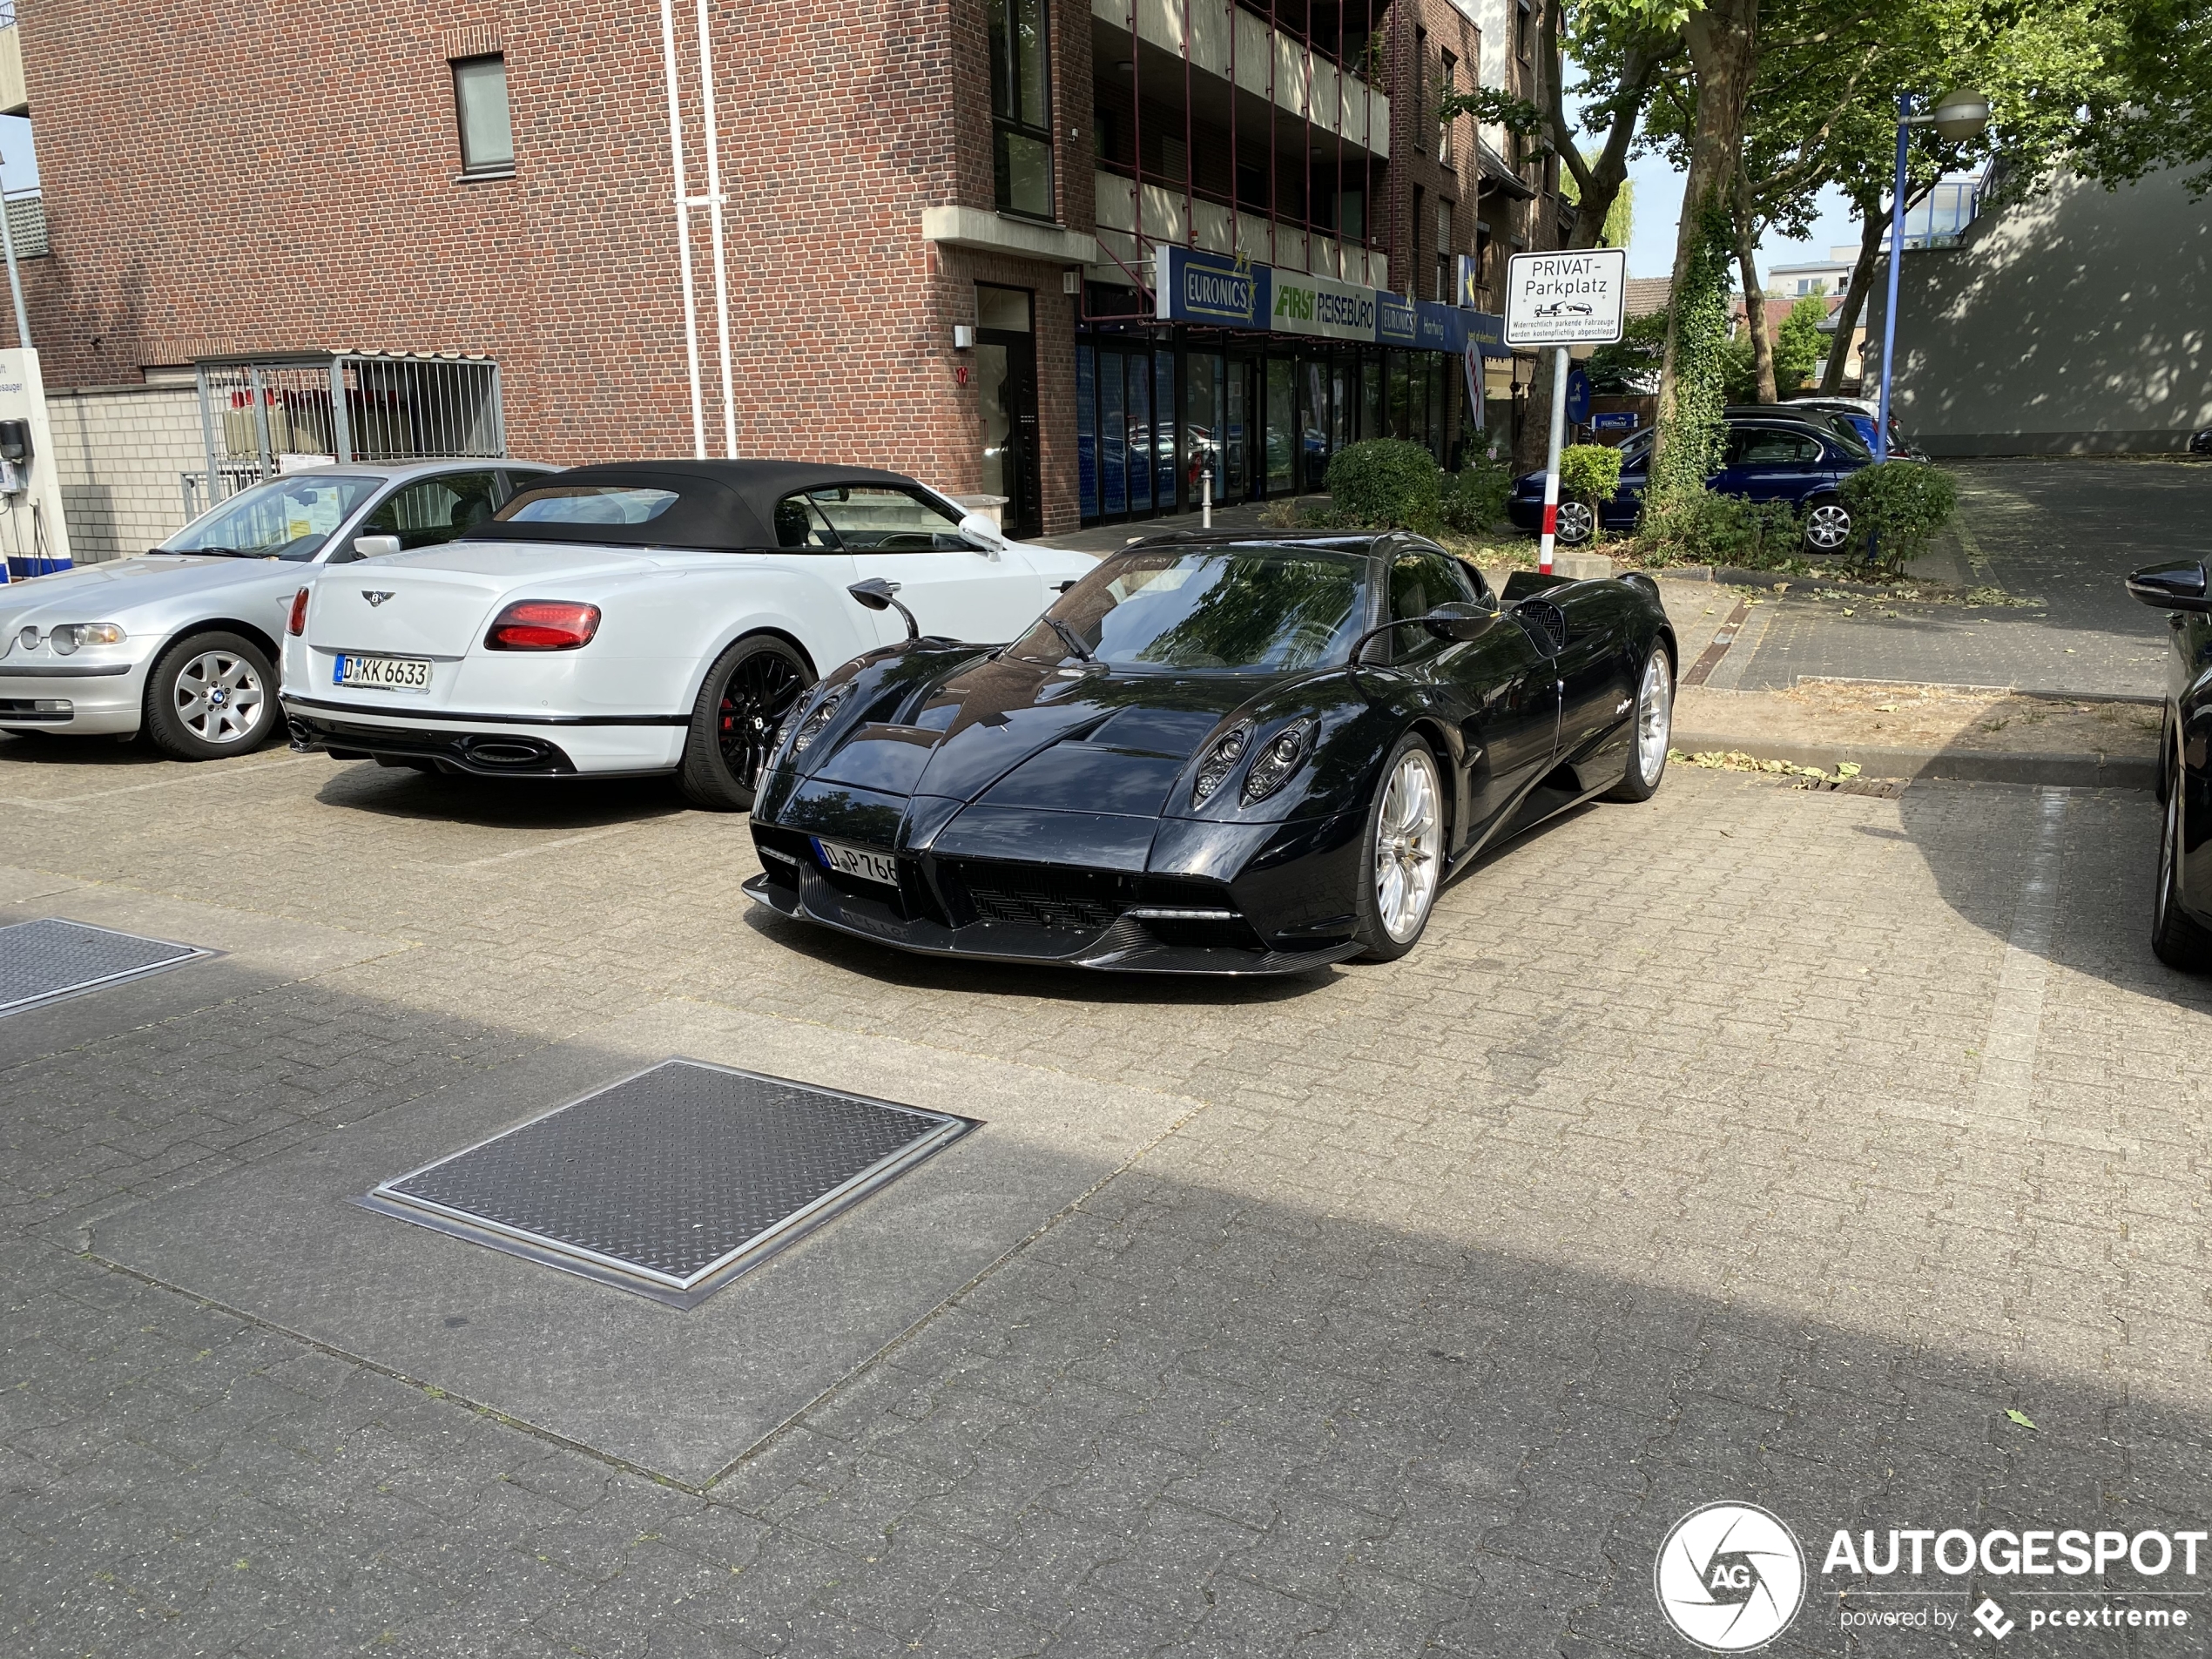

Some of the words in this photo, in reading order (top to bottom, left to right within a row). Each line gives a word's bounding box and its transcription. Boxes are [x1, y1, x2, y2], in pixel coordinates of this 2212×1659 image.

[1533, 259, 1602, 277] PRIVAT-
[1188, 273, 1248, 308] EURONICS
[1526, 278, 1607, 298] Parkplatz
[1274, 284, 1316, 320] FIRST
[1317, 292, 1374, 329] REISEBÜRO
[1384, 309, 1413, 332] EURONICS
[1423, 316, 1444, 341] Hartwig
[1514, 320, 1553, 328] Widerrechtlich
[1555, 320, 1582, 328] parkende
[1585, 319, 1615, 327] Fahrzeuge
[1533, 329, 1575, 338] kostenpflichtig
[1577, 327, 1615, 337] abgeschleppt
[343, 658, 354, 679] D
[361, 659, 383, 682] KK
[384, 661, 427, 685] 6633
